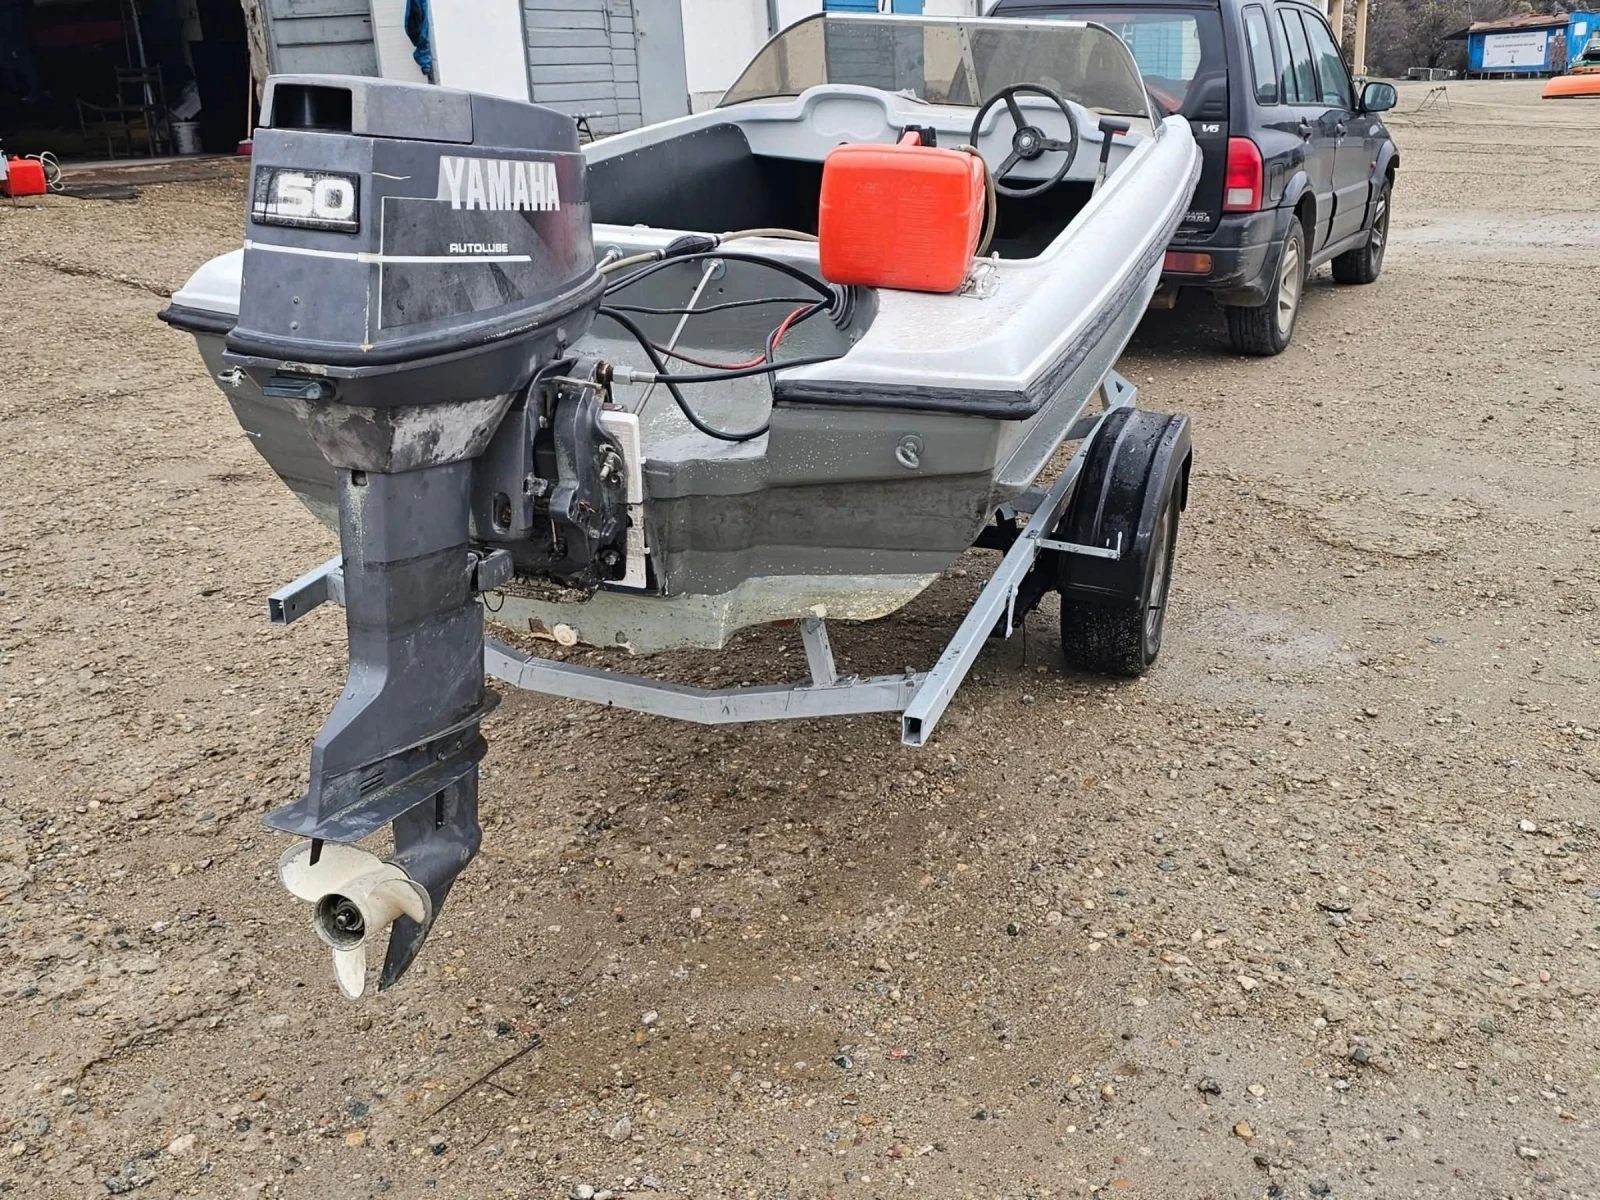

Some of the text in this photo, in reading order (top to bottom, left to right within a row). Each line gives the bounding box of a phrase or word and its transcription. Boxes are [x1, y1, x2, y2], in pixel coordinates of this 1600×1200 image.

[1202, 124, 1220, 133] V6
[277, 172, 355, 220] 50
[442, 156, 560, 211] YAMAHA
[449, 242, 509, 253] AUTOLUBE
